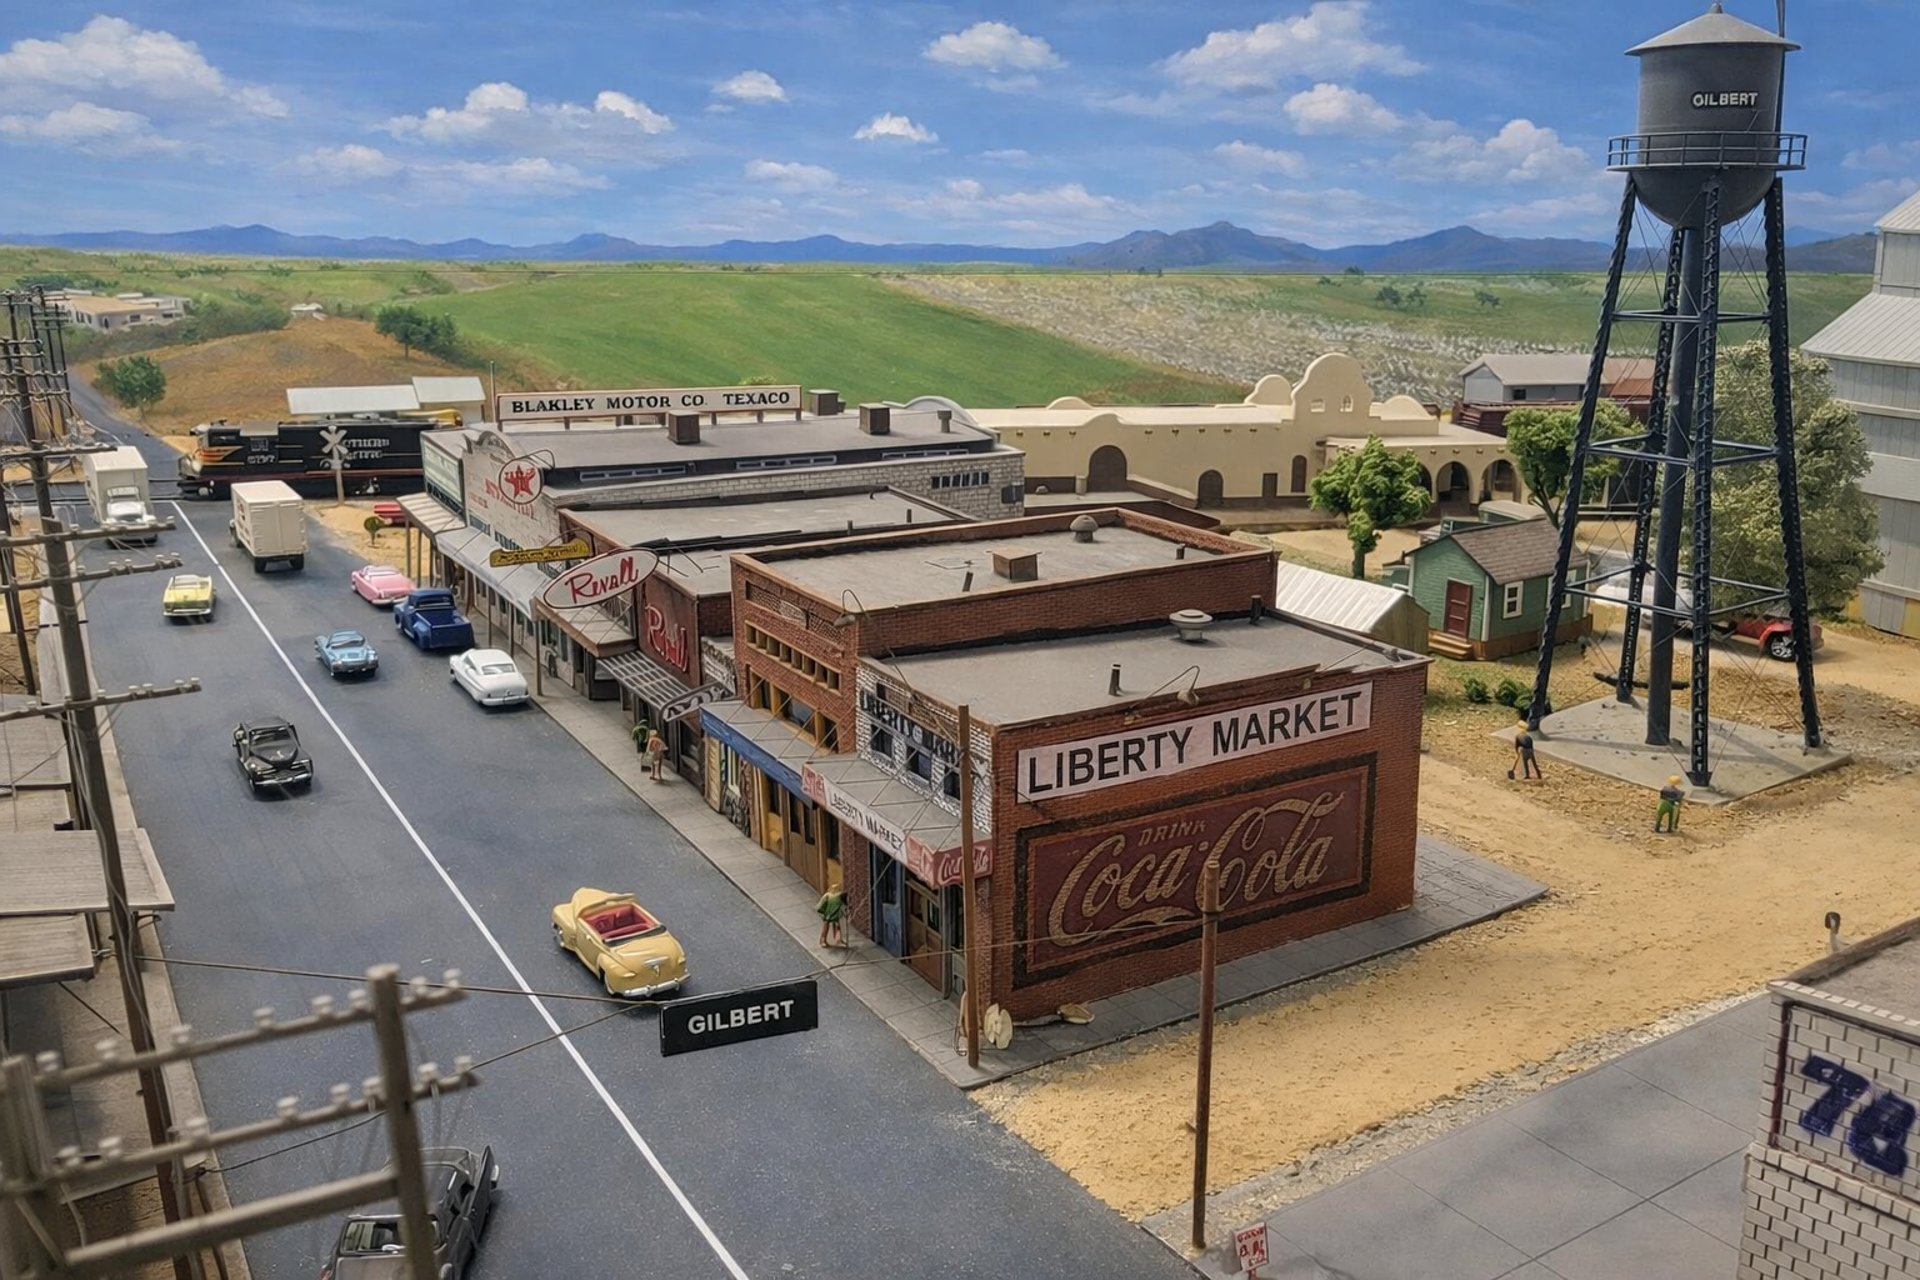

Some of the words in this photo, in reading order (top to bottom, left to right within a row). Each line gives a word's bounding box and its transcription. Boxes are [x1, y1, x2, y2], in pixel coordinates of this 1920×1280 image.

[512, 398, 595, 414] BLAKLEY
[606, 395, 671, 410] MOTOR
[723, 391, 790, 406] TEXACO
[1028, 726, 1194, 795] LIBERTY
[1212, 691, 1362, 757] MARKET
[1048, 791, 1344, 947] Coca-Cola
[687, 999, 795, 1035] GILBERT
